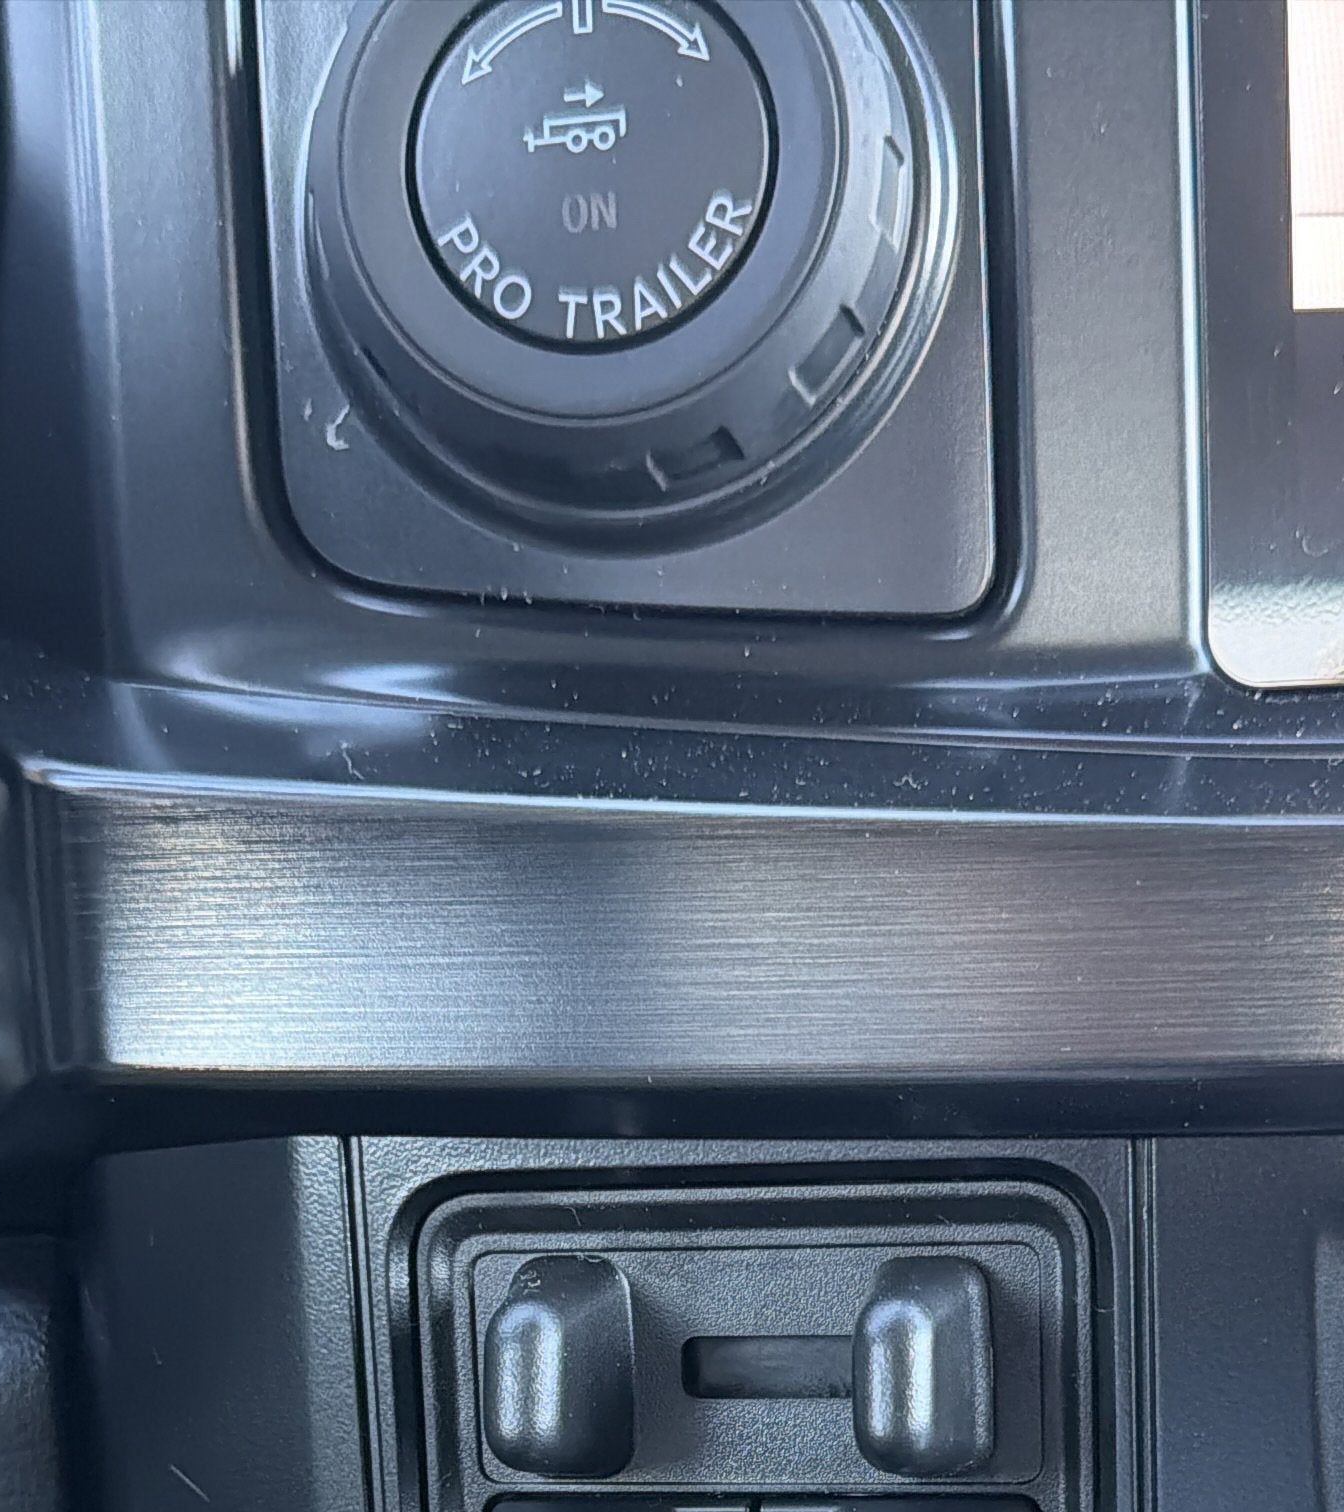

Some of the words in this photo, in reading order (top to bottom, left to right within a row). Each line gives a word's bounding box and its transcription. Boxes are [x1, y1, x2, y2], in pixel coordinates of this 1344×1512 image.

[561, 191, 619, 234] ON
[438, 216, 532, 320] PRO
[558, 196, 754, 339] TRAILER
